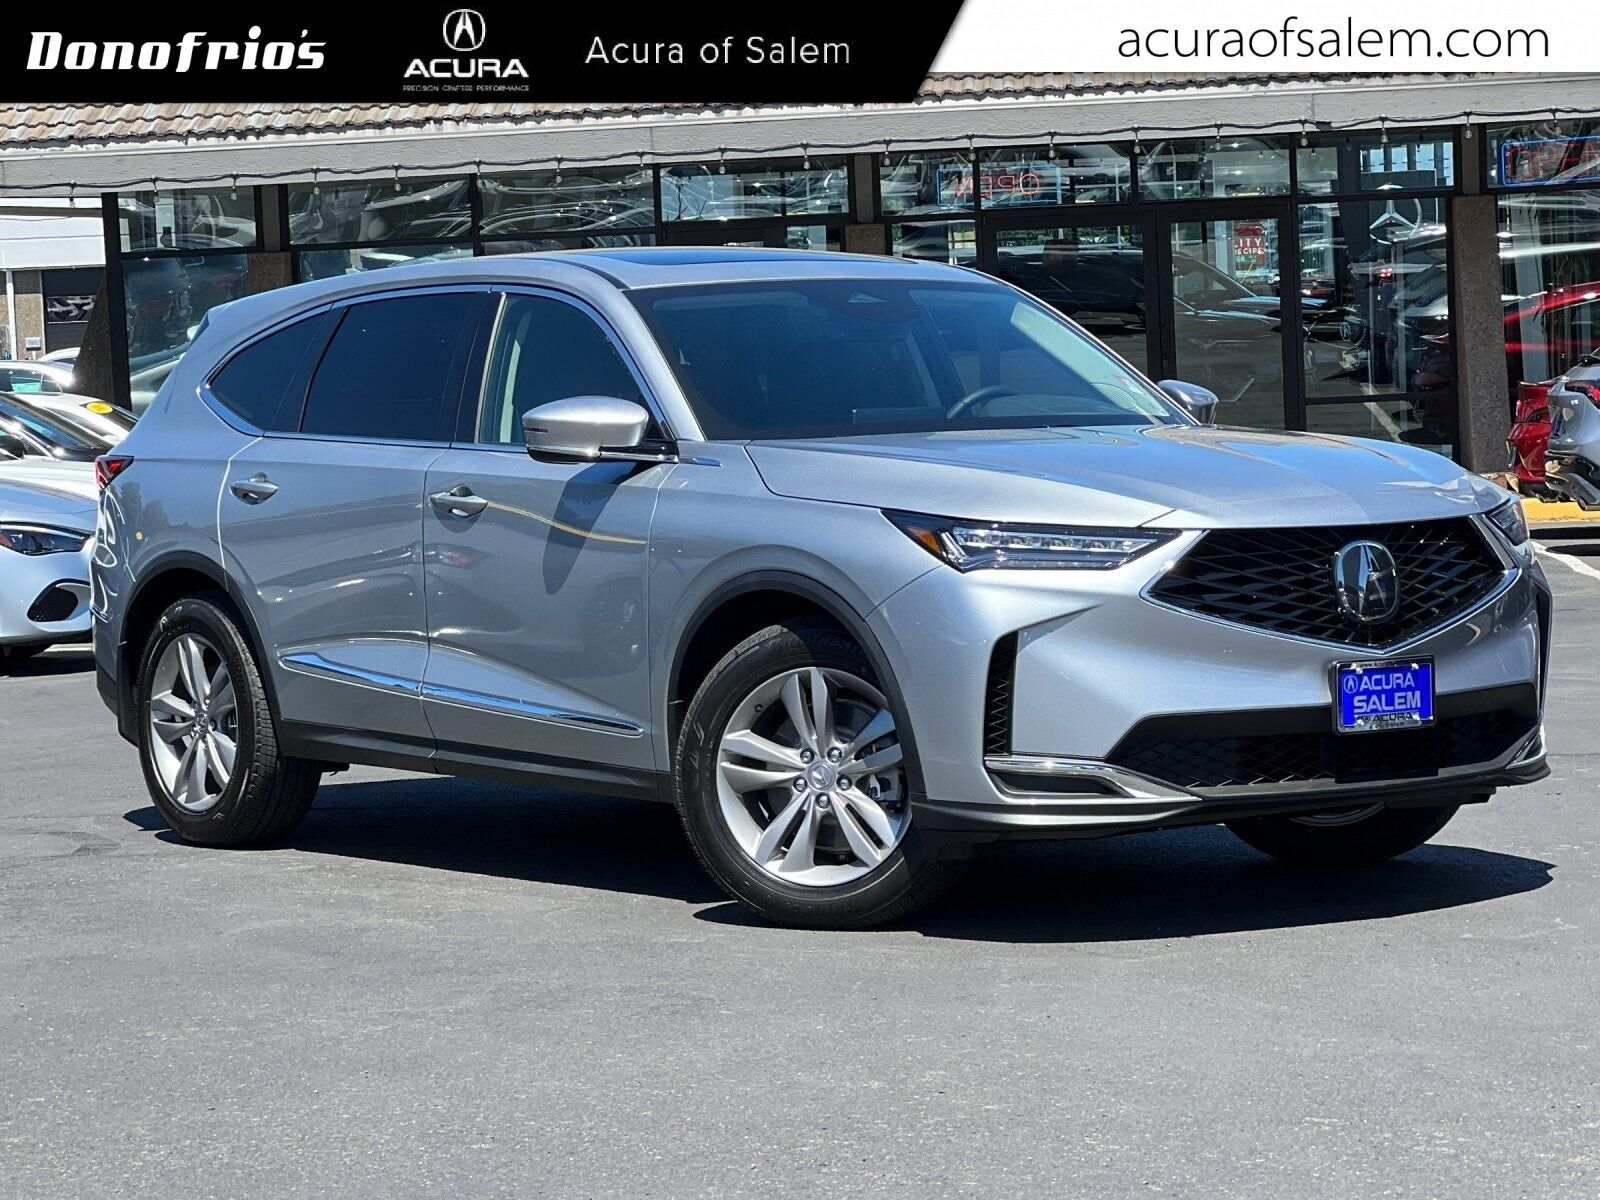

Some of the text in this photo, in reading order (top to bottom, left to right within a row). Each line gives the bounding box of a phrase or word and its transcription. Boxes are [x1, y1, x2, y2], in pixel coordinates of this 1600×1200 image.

[1359, 672, 1415, 692] ACURA
[1353, 690, 1421, 713] SALEM
[1372, 711, 1414, 723] ACURA
